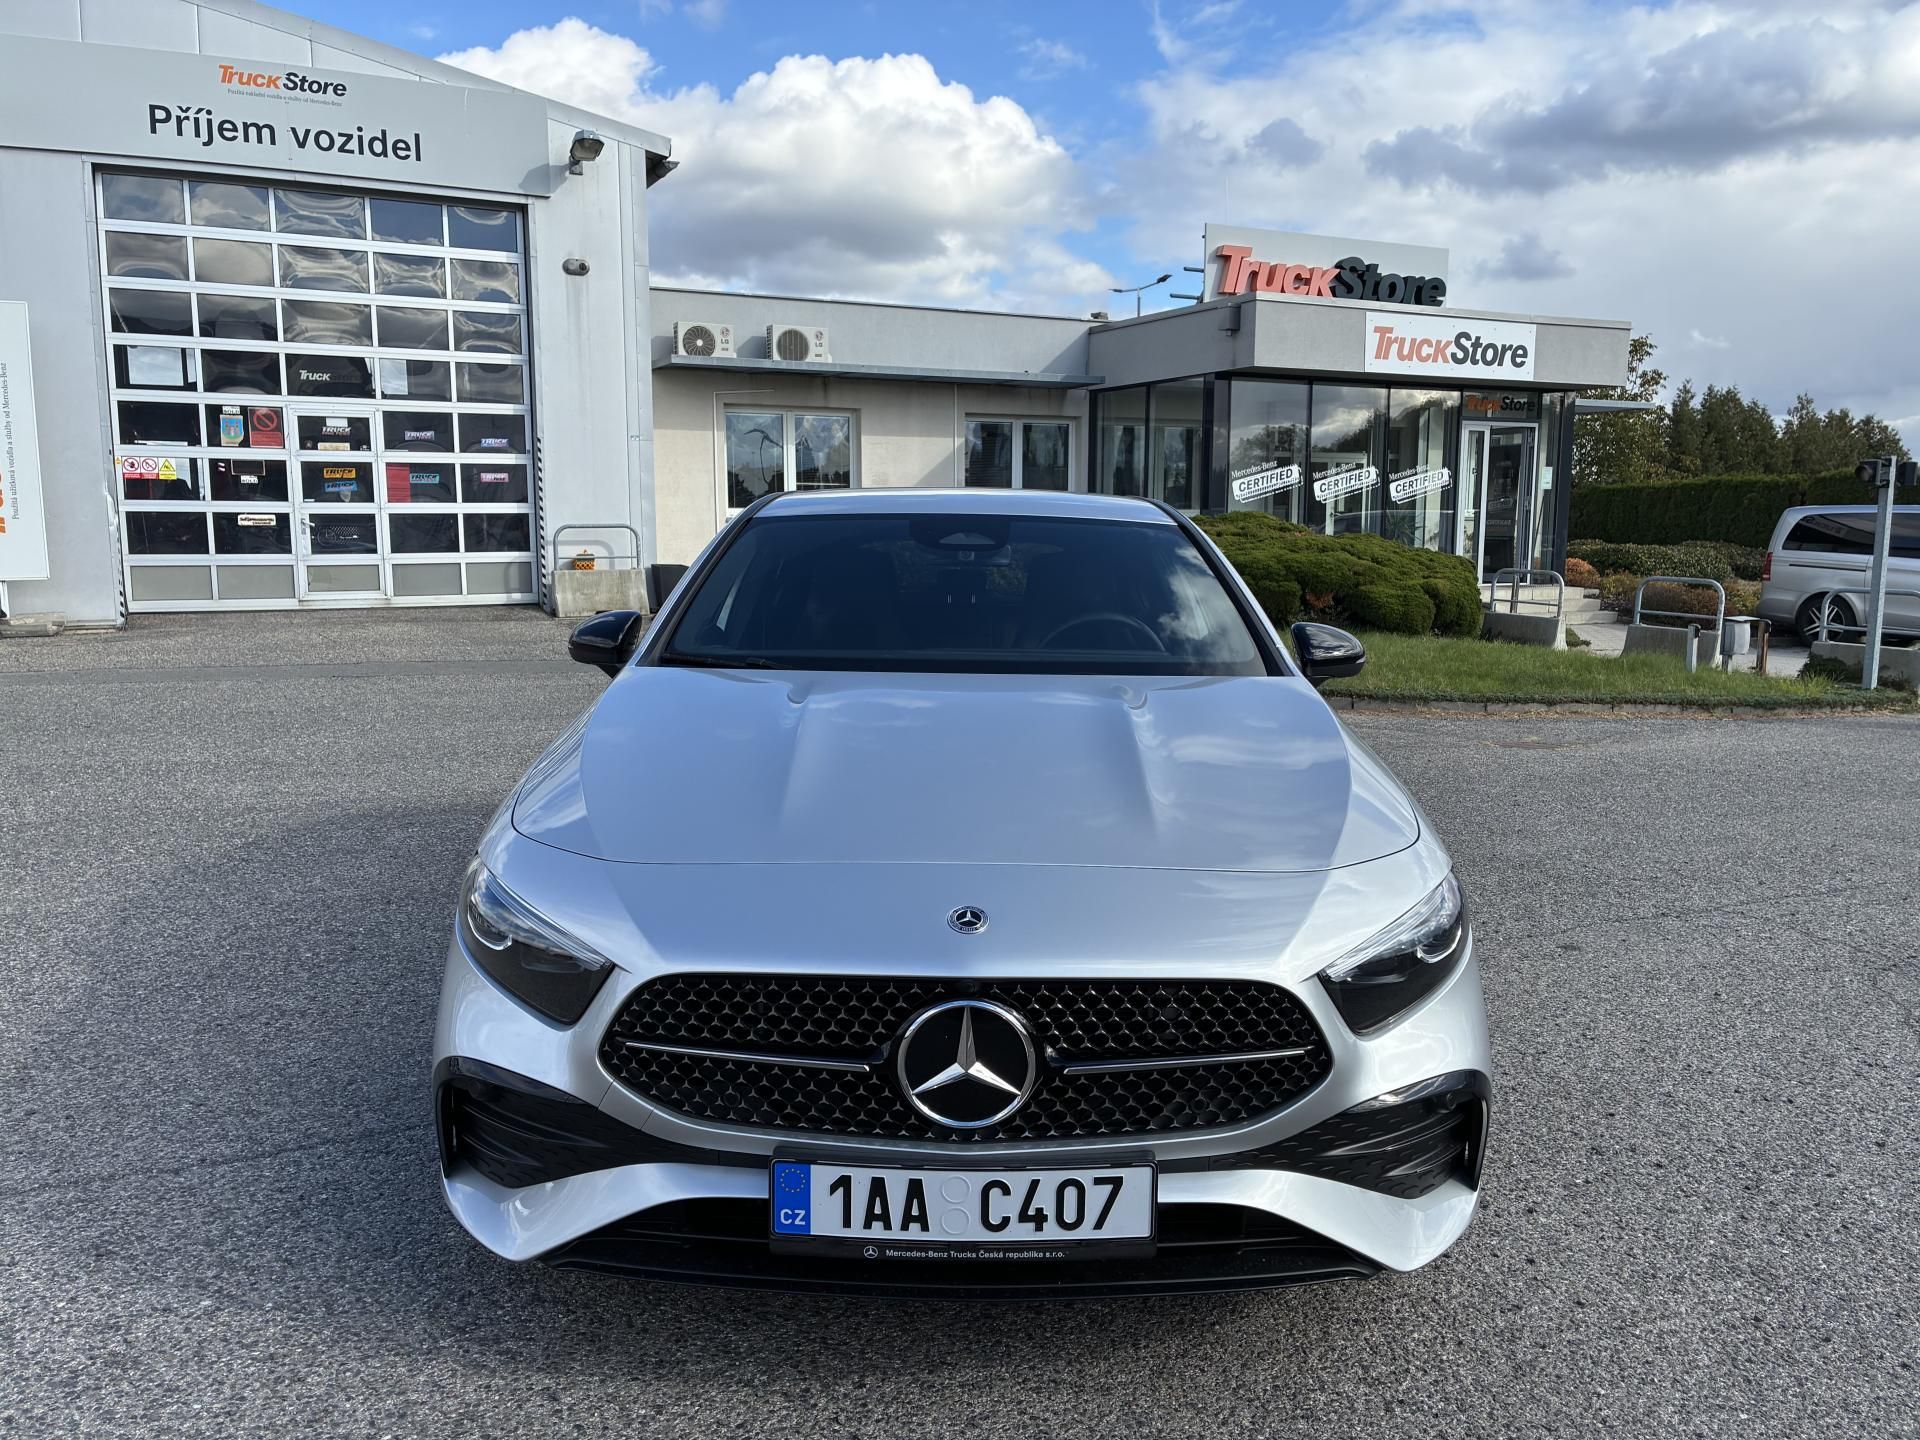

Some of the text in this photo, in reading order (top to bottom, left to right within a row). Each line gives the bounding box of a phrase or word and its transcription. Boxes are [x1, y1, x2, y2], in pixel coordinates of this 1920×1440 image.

[148, 103, 422, 162] Příjem vozidel
[1216, 244, 1447, 308] TruckStore
[1373, 325, 1529, 369] TruckStore
[1231, 460, 1278, 479] Mercedes-Benz
[1238, 468, 1293, 492] CERTIFIED
[1312, 461, 1357, 480] Mercedes-Benz
[1319, 469, 1371, 493] CERTIFIED
[1388, 463, 1431, 481] Mercedes-Benz
[1395, 471, 1444, 494] CERTIFIED
[829, 1174, 1124, 1233] 1AA C407
[780, 1208, 806, 1225] CZ
[885, 1249, 948, 1258] Mercedes-Benz
[978, 1249, 1004, 1259] Česká
[1005, 1250, 1044, 1260] republika
[1045, 1250, 1067, 1259] s.r.o.
